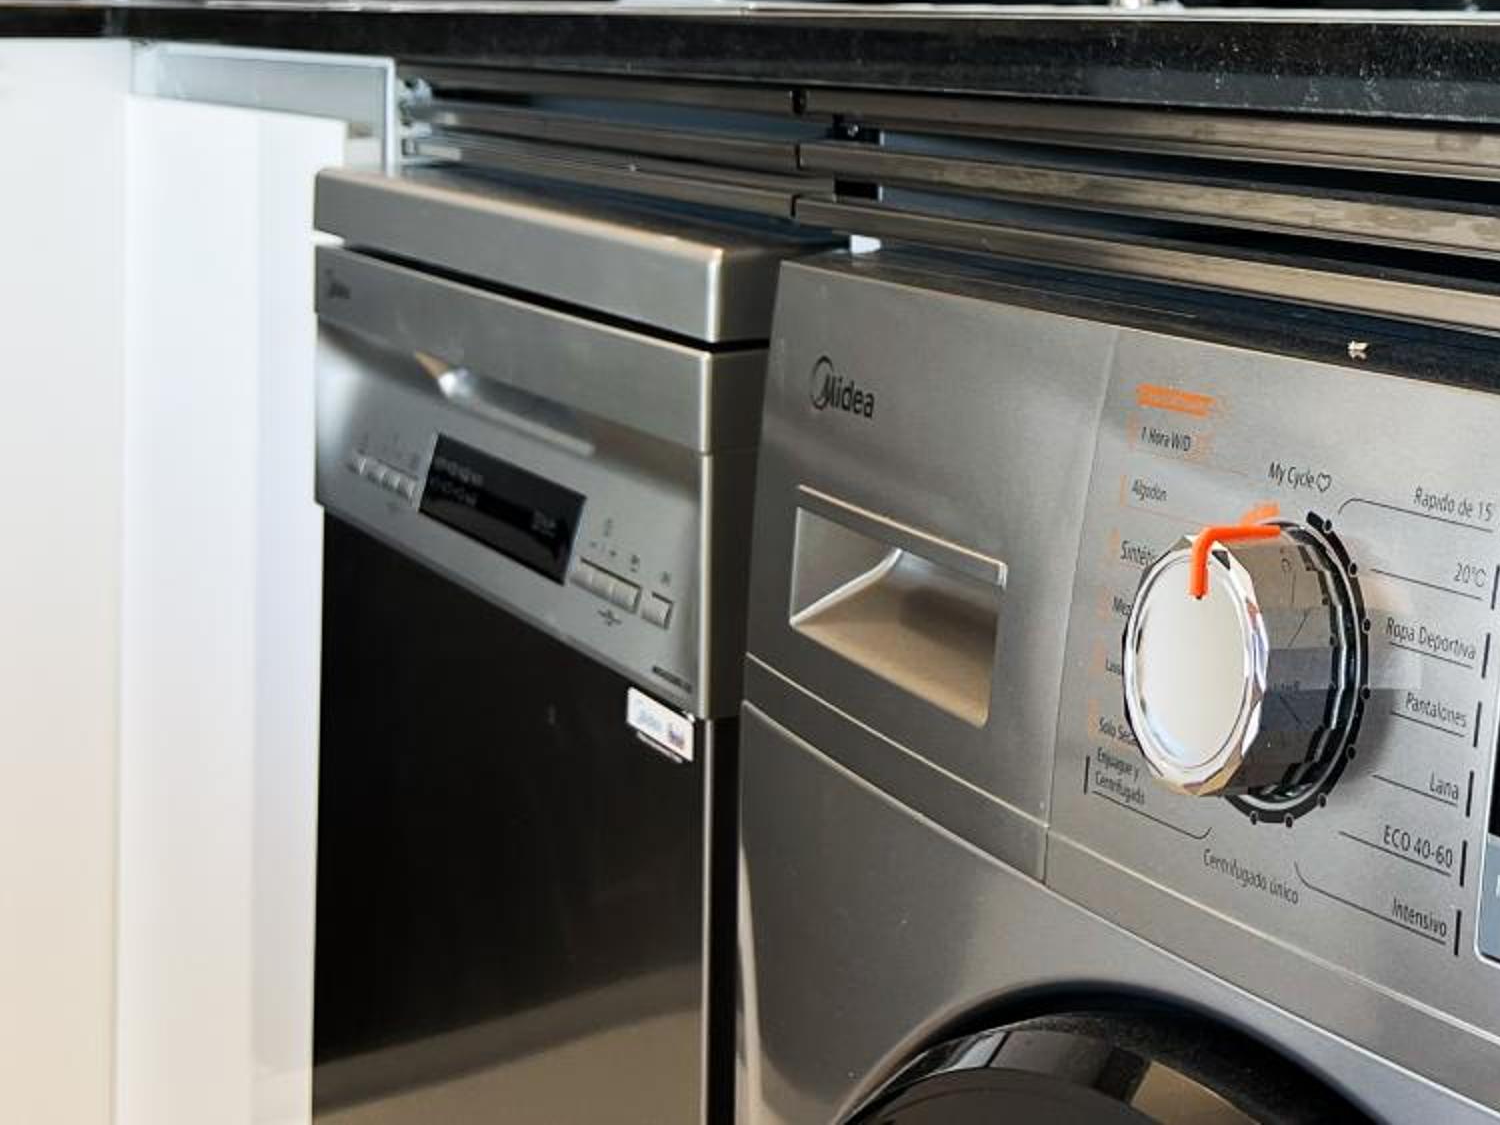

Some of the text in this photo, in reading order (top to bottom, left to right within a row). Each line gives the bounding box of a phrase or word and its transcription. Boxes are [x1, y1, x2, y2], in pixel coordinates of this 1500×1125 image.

[812, 360, 875, 418] Midea
[1267, 461, 1315, 489] My Cycle
[1458, 497, 1474, 518] de
[1453, 561, 1487, 589] 20°C
[1386, 616, 1477, 660] Ropa Deportiva
[1405, 691, 1467, 728] Pantalones
[1428, 771, 1459, 801] Lana
[1384, 824, 1453, 869] ECO 40-60
[1392, 896, 1447, 938] Intensivo
